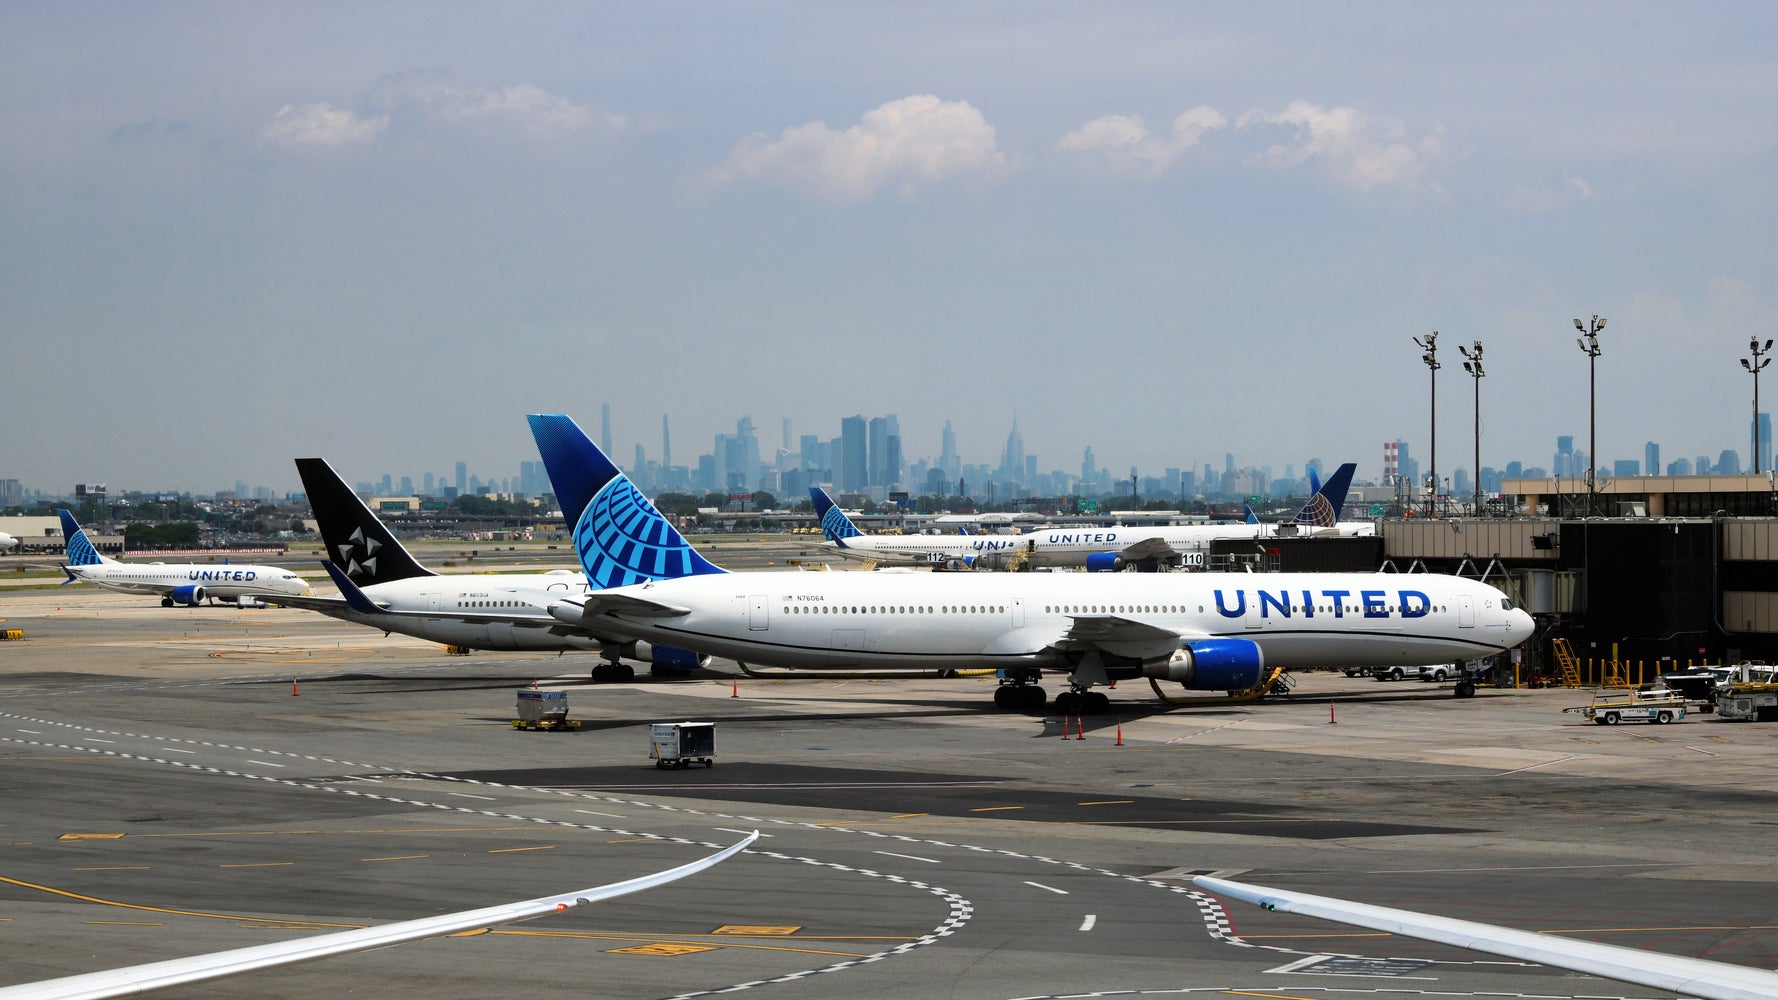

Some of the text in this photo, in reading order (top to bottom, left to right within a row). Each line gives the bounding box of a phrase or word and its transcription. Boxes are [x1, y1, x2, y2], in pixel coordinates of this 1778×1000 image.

[1049, 533, 1117, 544] UNITED
[927, 552, 944, 562] 112
[1182, 553, 1203, 565] 110
[188, 570, 257, 582] UNITED
[797, 594, 825, 602] N76064
[1213, 589, 1432, 619] UNITED
